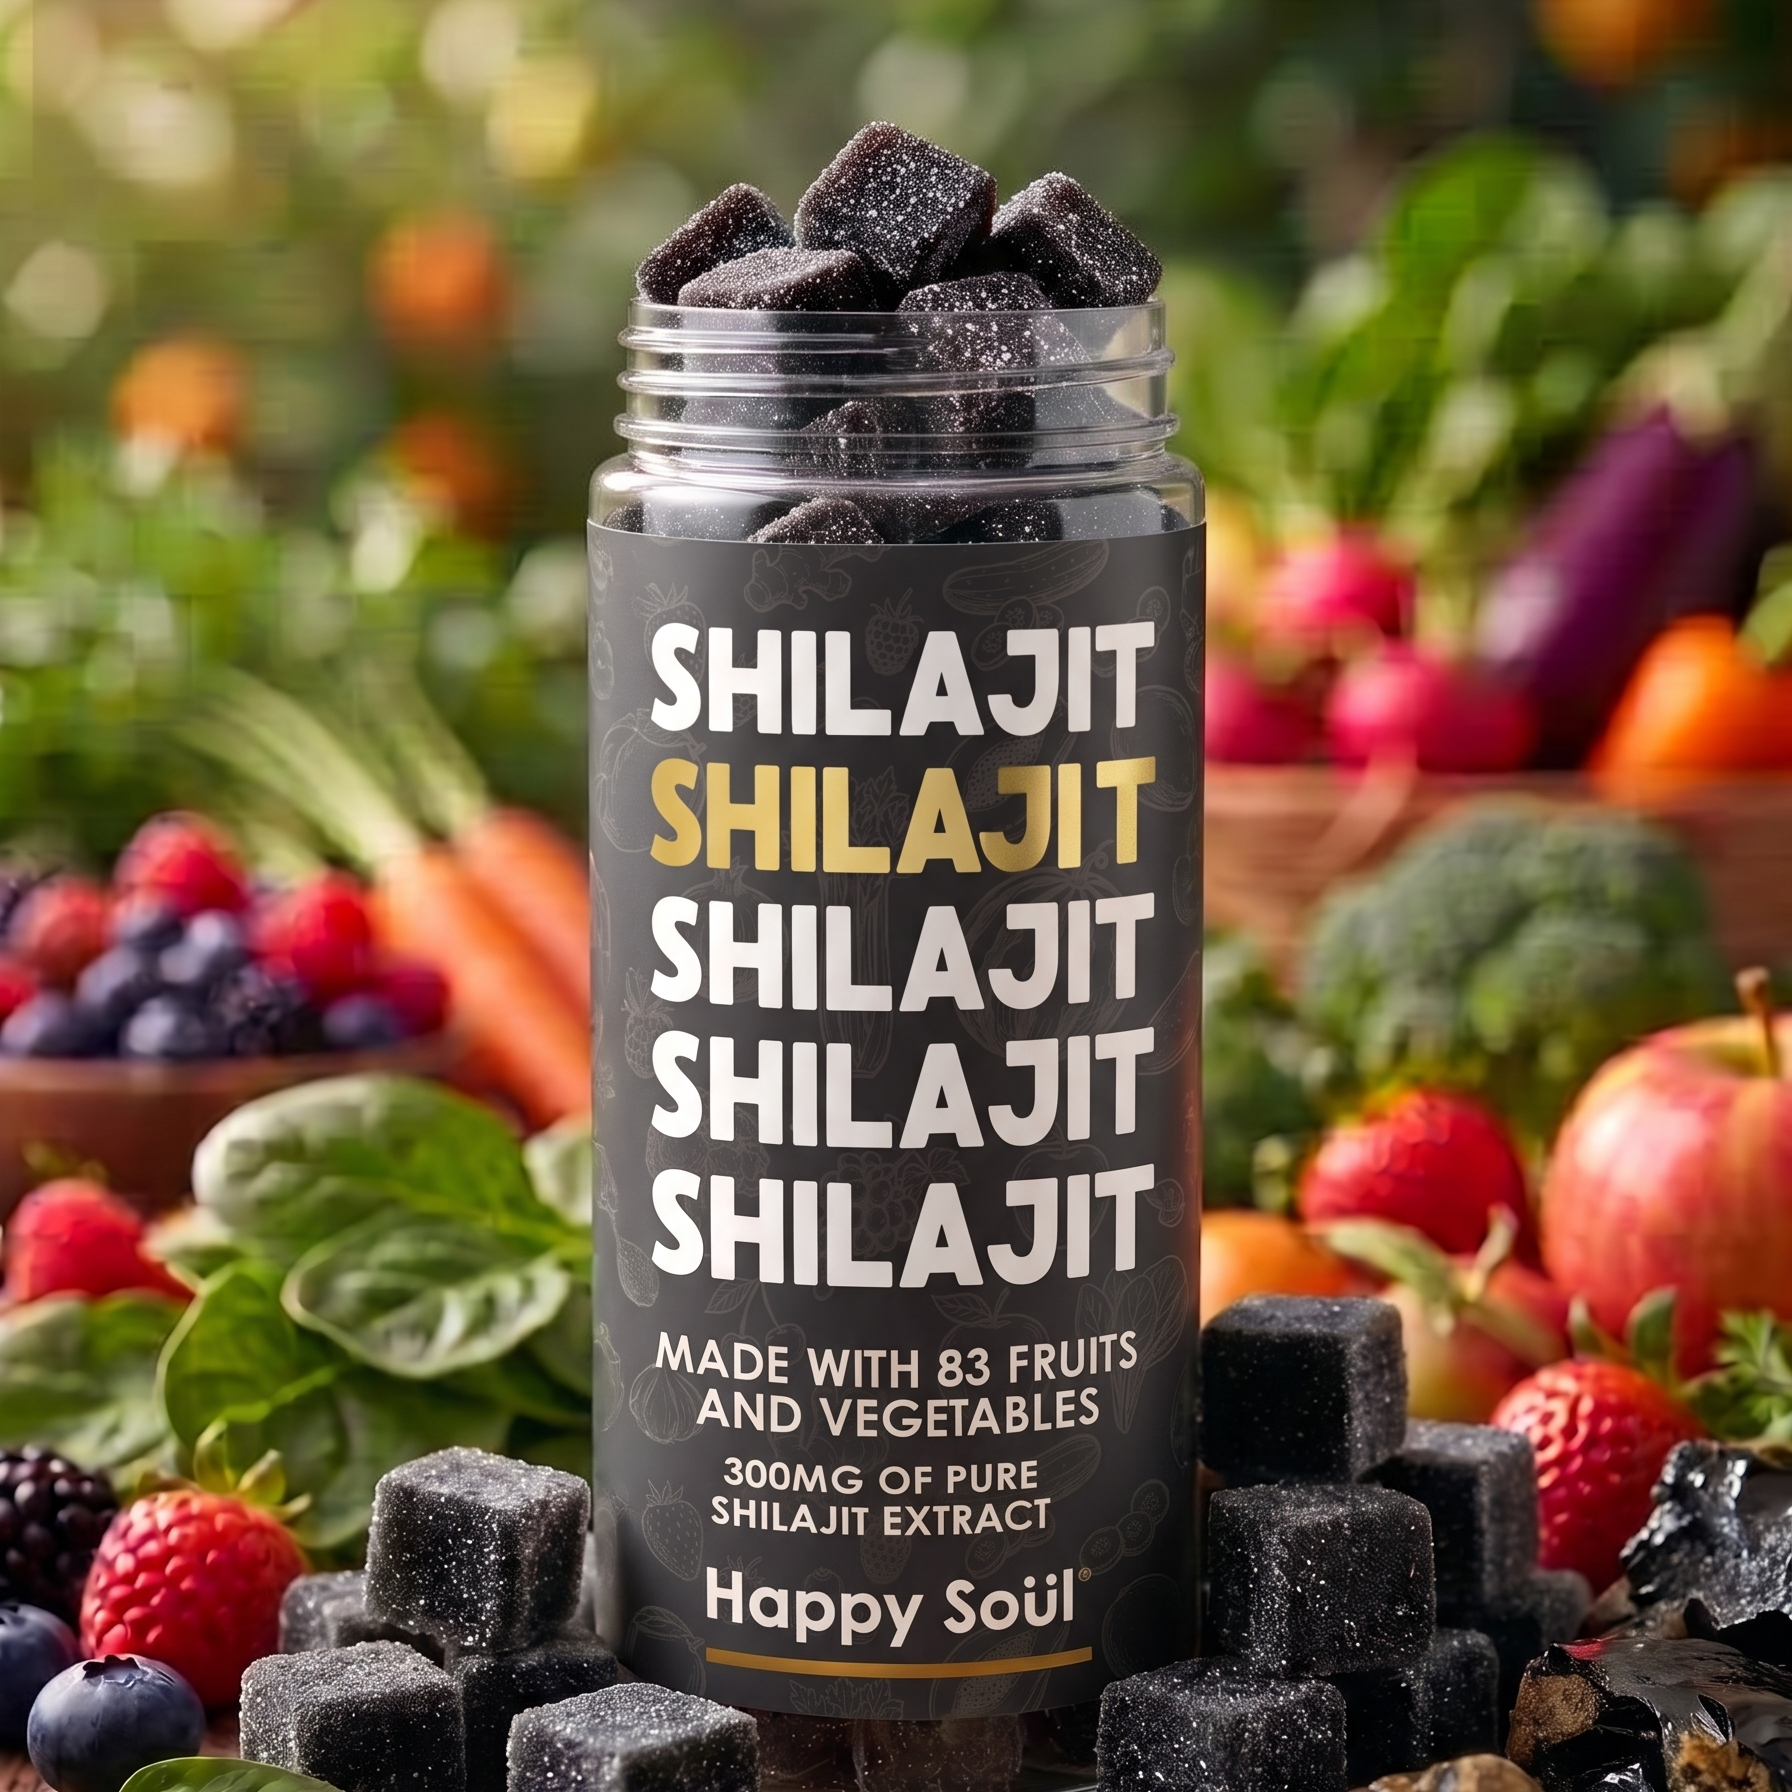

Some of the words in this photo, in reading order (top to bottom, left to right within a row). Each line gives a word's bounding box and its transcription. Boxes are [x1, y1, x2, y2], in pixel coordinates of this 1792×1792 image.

[650, 621, 1155, 736] SHILAJIT
[650, 757, 1157, 873] SHILAJIT
[650, 892, 1155, 1011] SHILAJIT
[650, 1026, 1155, 1148] SHILAJIT
[650, 1163, 1155, 1287] SHILAJIT
[655, 1331, 790, 1385] MADE
[807, 1347, 920, 1389] WITH
[937, 1347, 991, 1388] 83
[1009, 1330, 1138, 1384] FRUITS
[696, 1387, 802, 1433] AND
[818, 1387, 1100, 1438] VEGETABLES
[711, 1495, 869, 1536] SHILAJIT
[883, 1497, 1051, 1536] EXTRACT
[723, 1456, 863, 1495] 300MG
[878, 1465, 932, 1495] OF
[947, 1460, 1038, 1494] PURE
[706, 1567, 924, 1648] Happy
